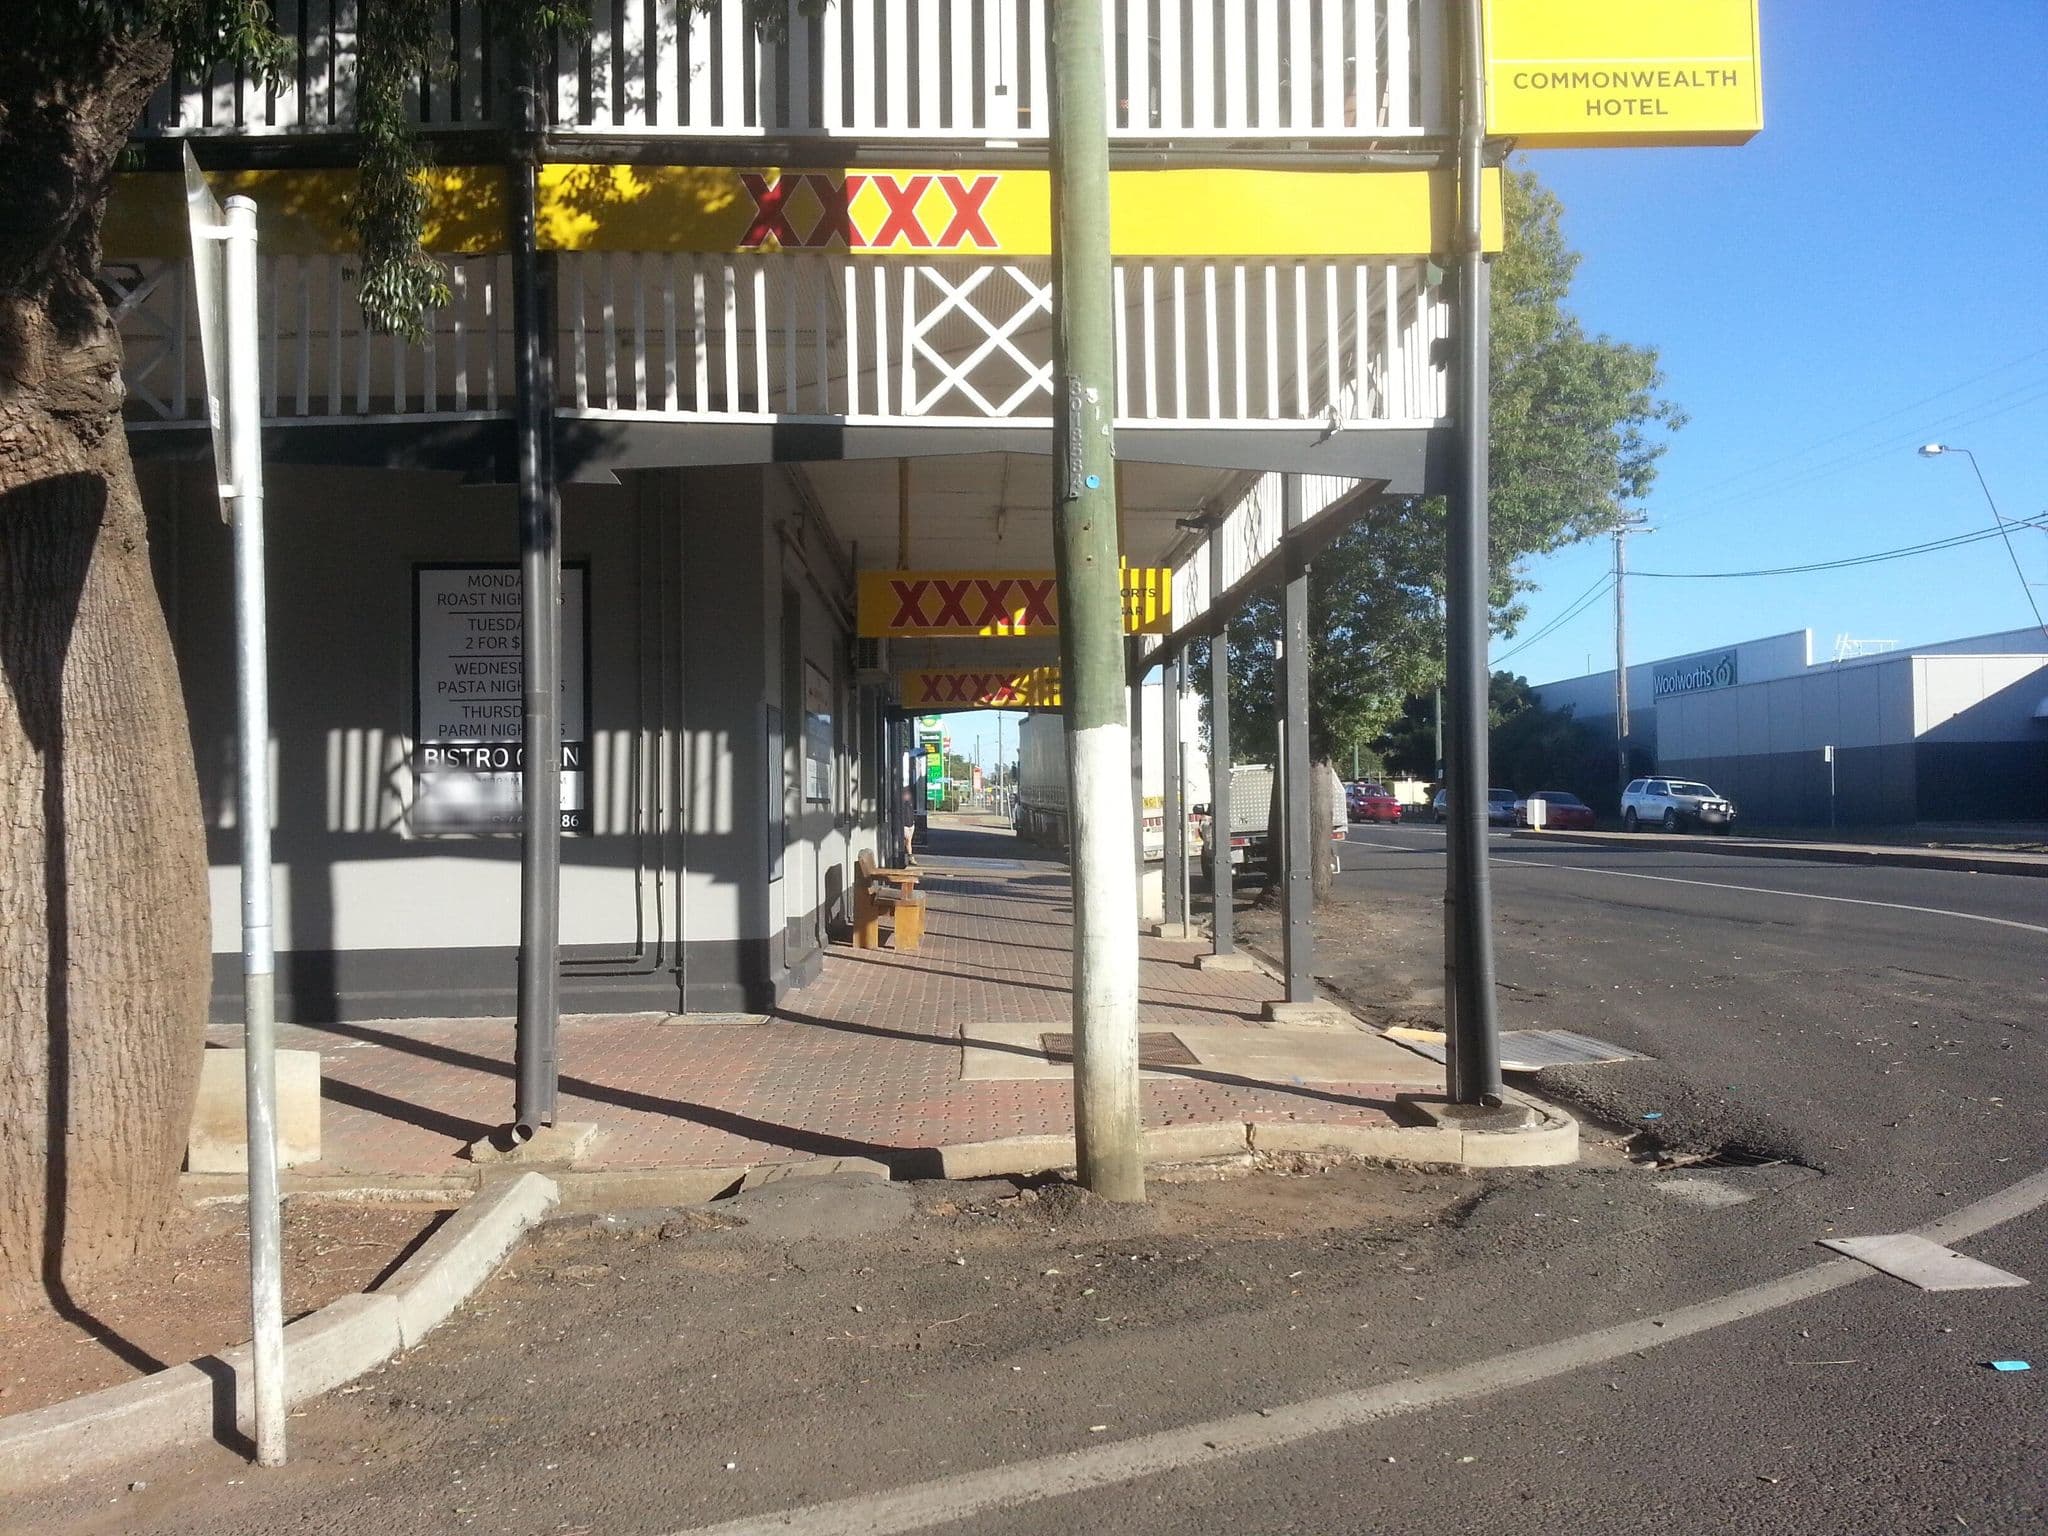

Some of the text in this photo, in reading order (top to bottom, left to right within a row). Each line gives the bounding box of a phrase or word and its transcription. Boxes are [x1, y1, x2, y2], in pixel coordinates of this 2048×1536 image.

[1513, 70, 1738, 89] COMMONWEALTH
[1586, 98, 1669, 116] HOTEL
[738, 173, 1000, 247] XXXX
[468, 575, 522, 588] MONDA
[437, 593, 487, 606] ROAST
[1120, 588, 1156, 598] ORTS
[889, 579, 1056, 627] XXXX
[468, 619, 523, 631] TUESDA
[465, 637, 473, 650] 2
[478, 637, 507, 649] FOR
[455, 662, 523, 675] WEDNES
[1654, 665, 1712, 694] Woolworths
[438, 681, 487, 694] PASTA
[920, 674, 1018, 702] XXXX
[462, 706, 523, 718] THURSD
[439, 725, 486, 737] PARMI
[424, 747, 509, 768] BISTRO
